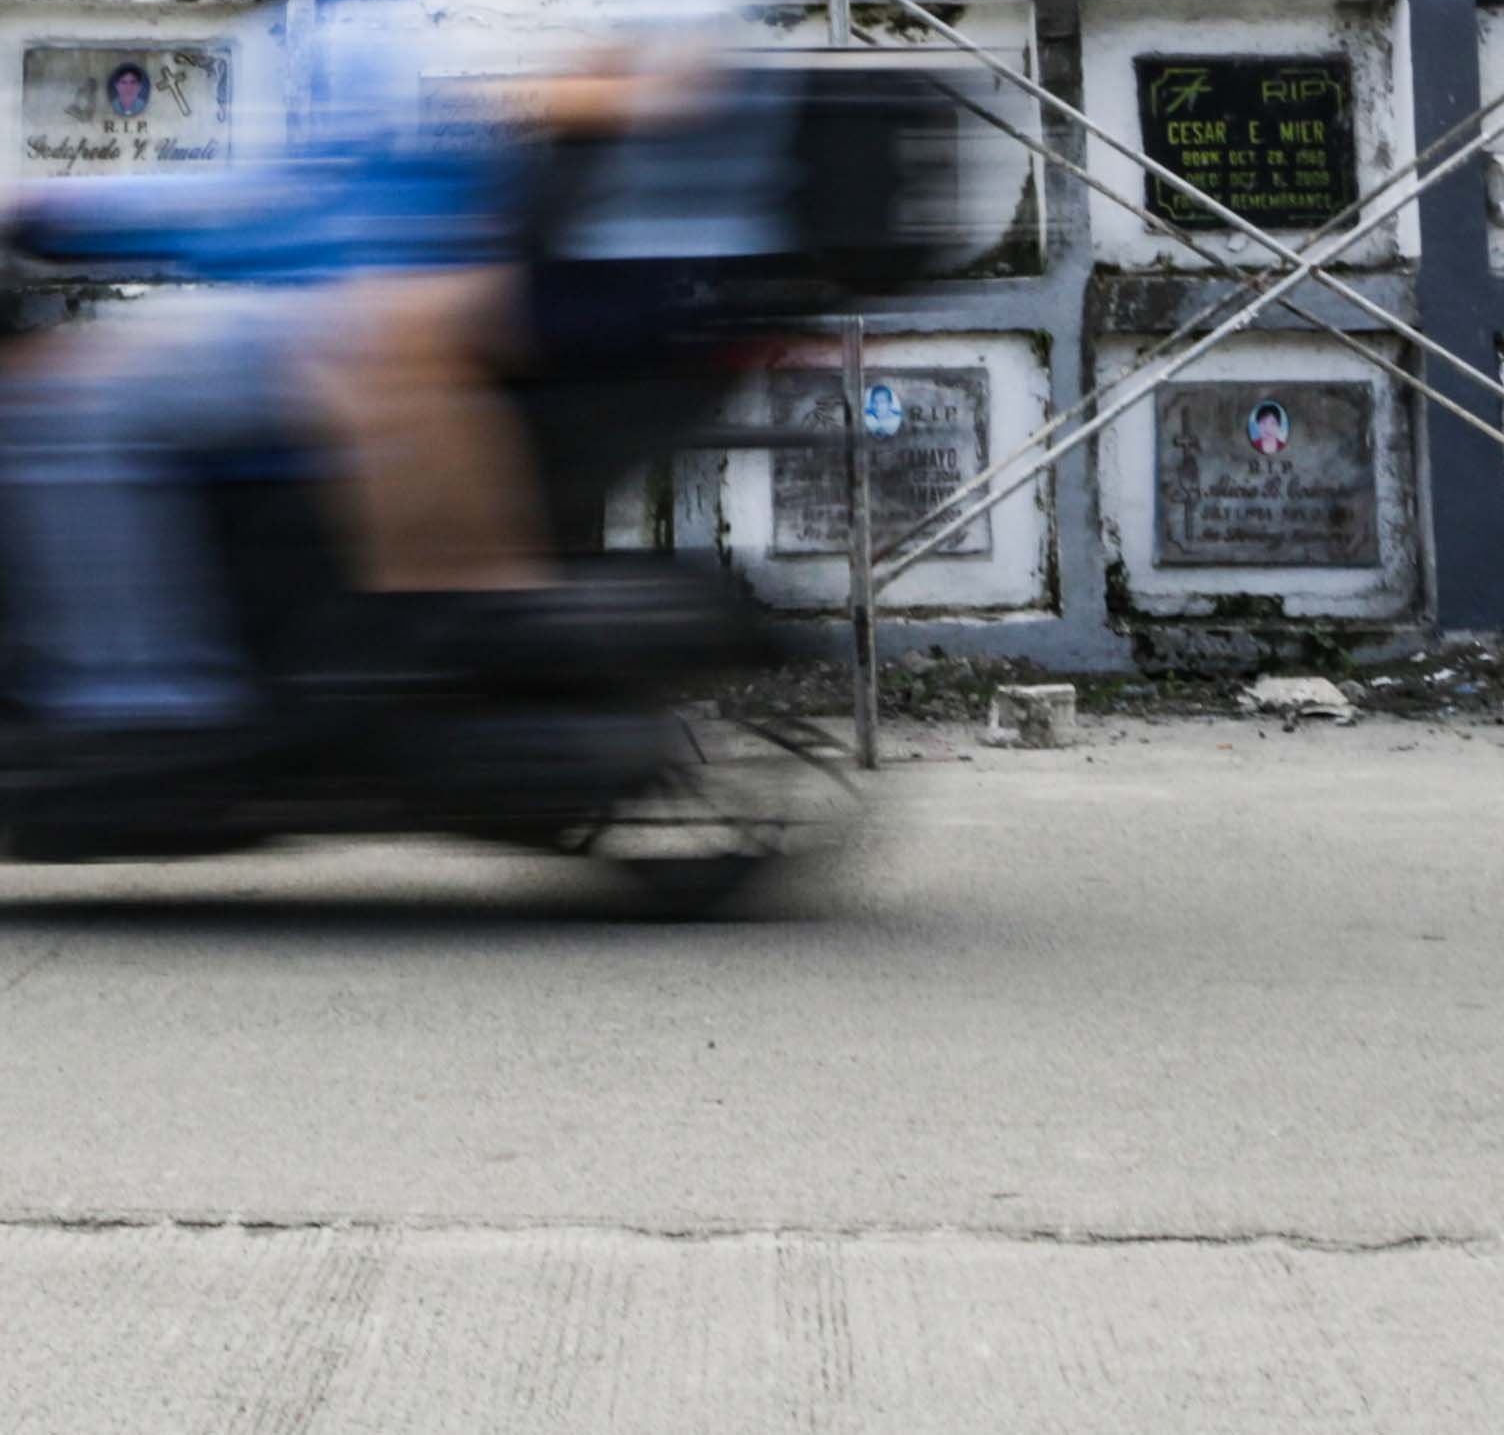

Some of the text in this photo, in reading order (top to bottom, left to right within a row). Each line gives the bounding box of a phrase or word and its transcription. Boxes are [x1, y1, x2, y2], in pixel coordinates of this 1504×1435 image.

[1262, 79, 1327, 103] RIP
[1167, 120, 1228, 146] CESAR
[1279, 119, 1326, 144] MIER
[26, 134, 219, 170] Godofredo Umali
[1230, 194, 1332, 210] REMEMBRANCE
